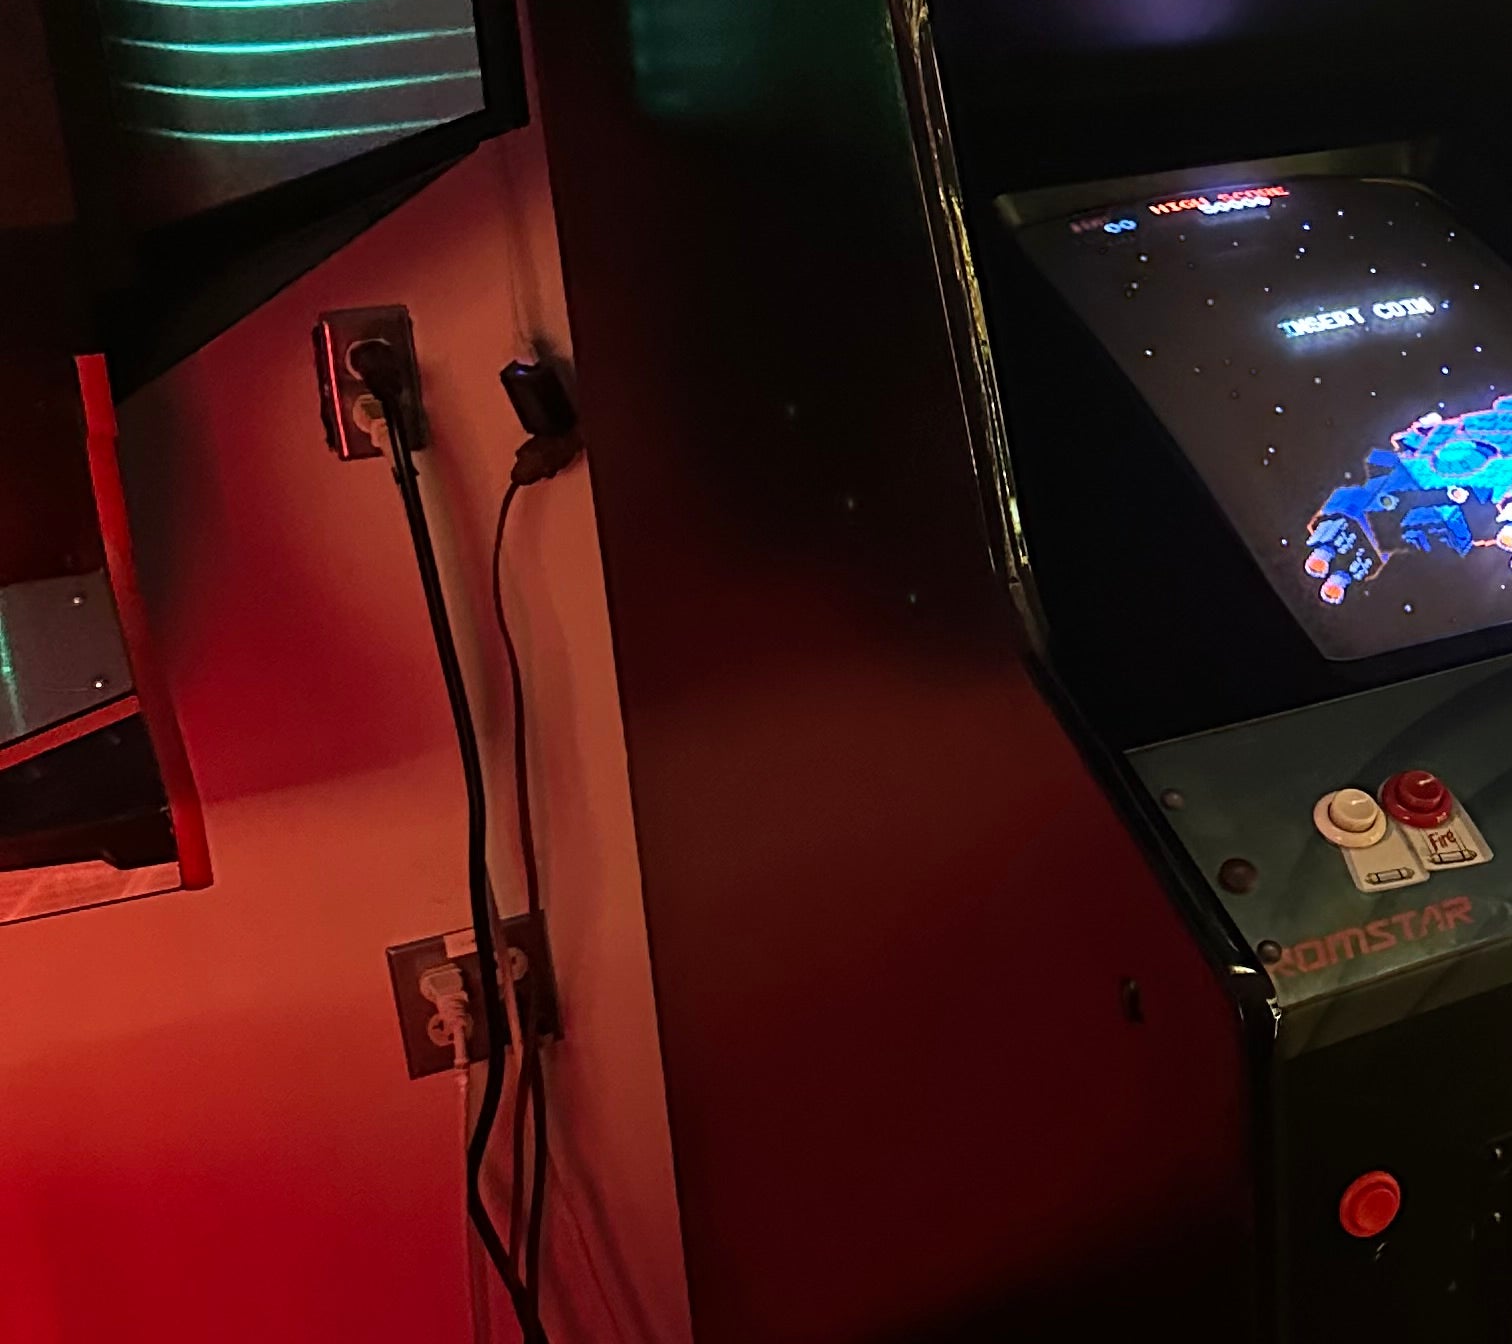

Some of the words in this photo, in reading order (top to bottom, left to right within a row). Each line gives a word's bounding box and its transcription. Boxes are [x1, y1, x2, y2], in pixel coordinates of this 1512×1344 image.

[1278, 307, 1366, 337] INSERT
[1372, 296, 1435, 320] COIN
[1428, 828, 1457, 853] Fire
